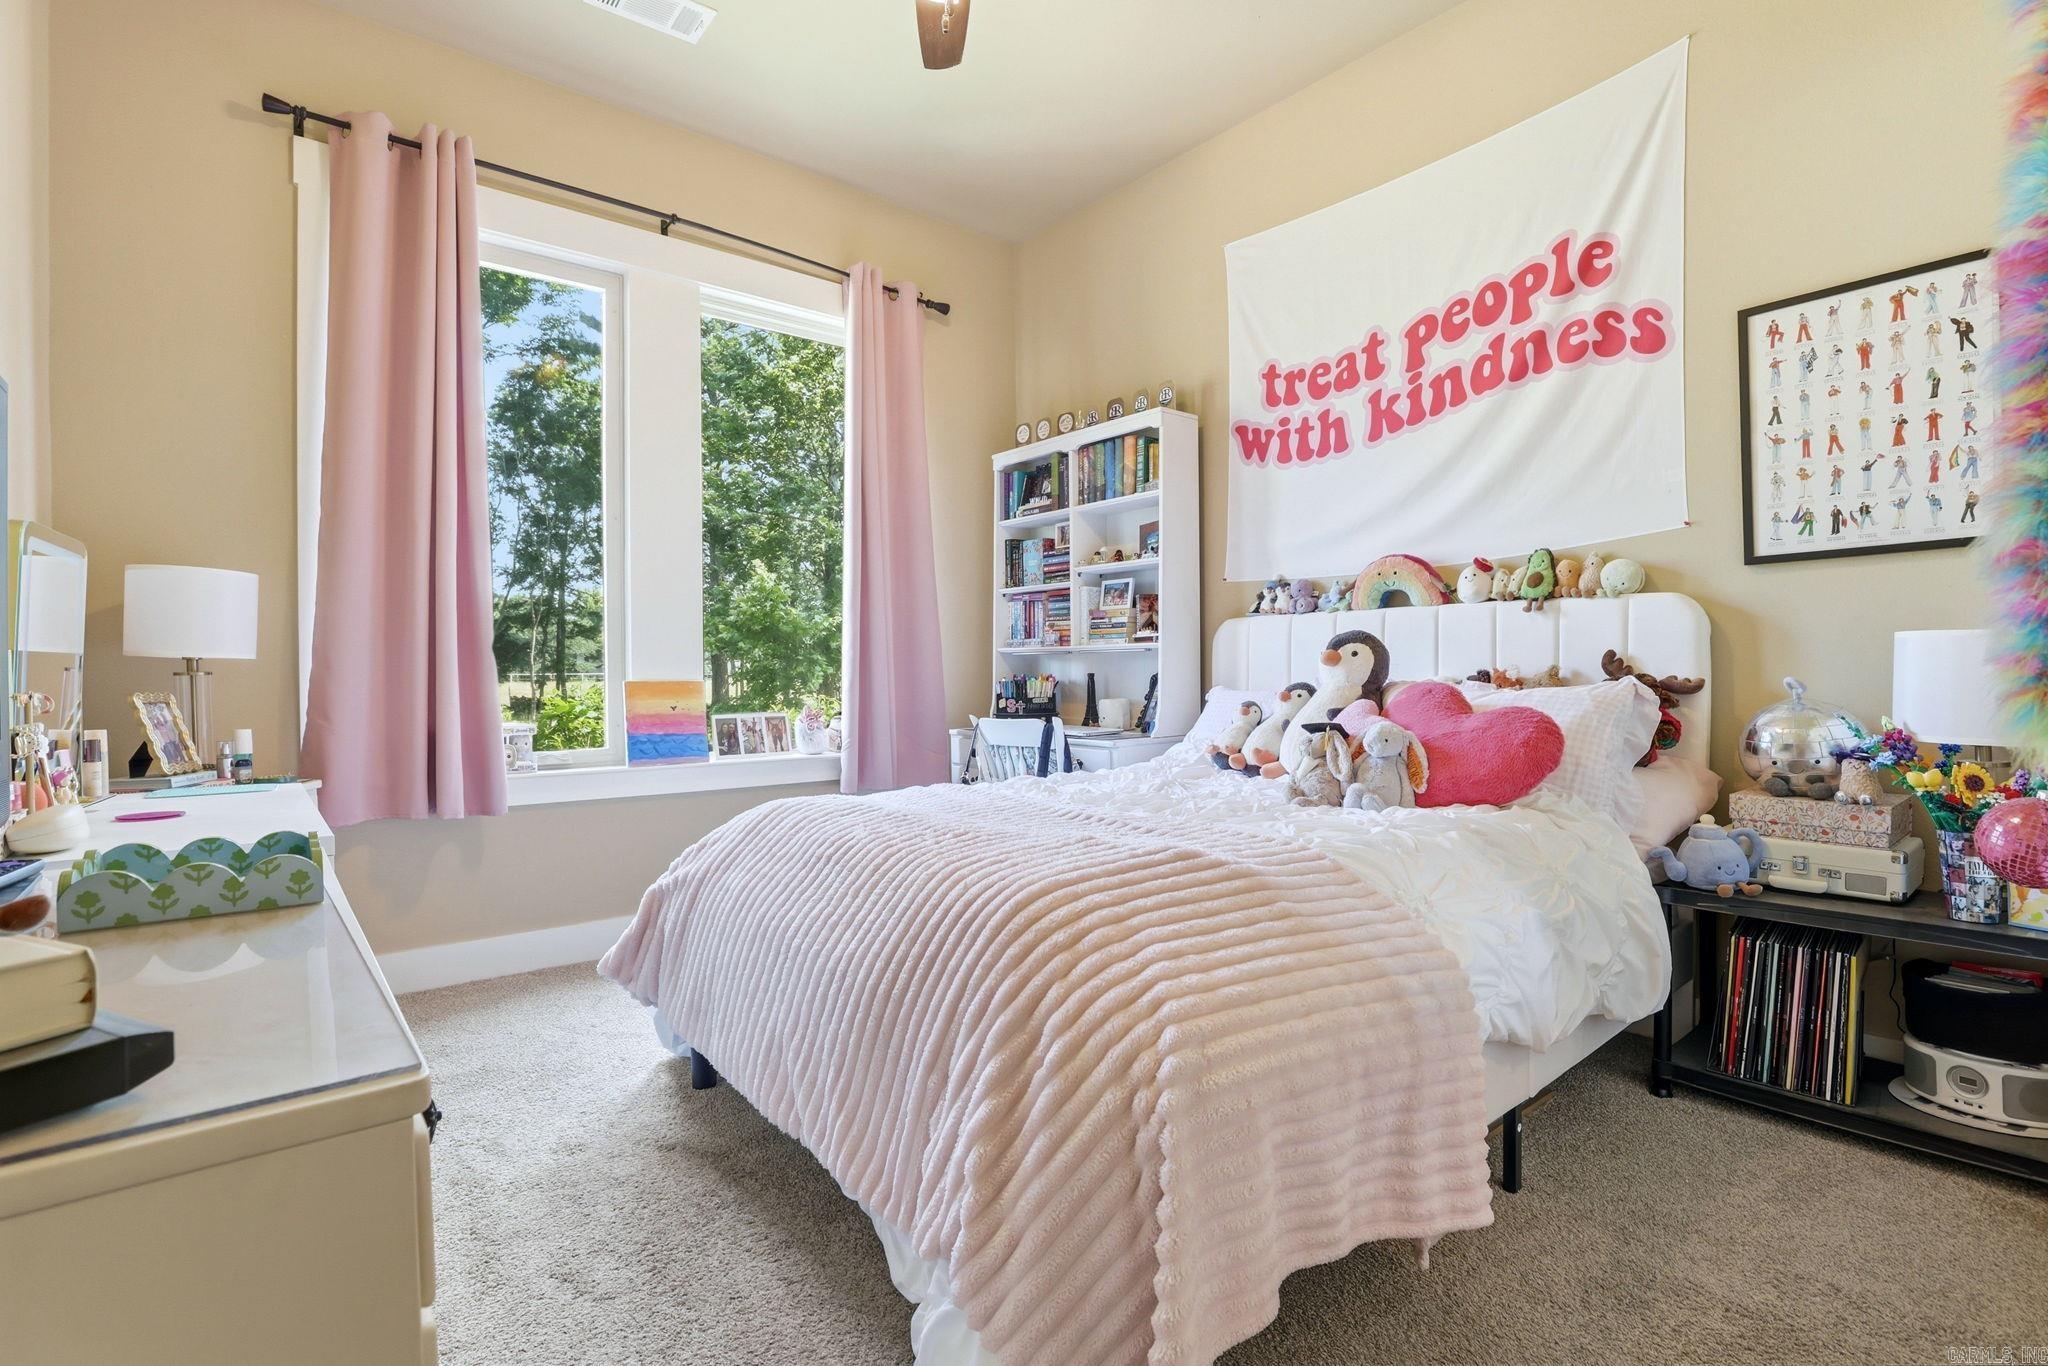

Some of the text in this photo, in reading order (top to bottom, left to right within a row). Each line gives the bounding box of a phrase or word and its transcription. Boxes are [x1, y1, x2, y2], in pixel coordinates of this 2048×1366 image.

[1235, 306, 1667, 465] with kindness
[1261, 237, 1614, 408] treat people
